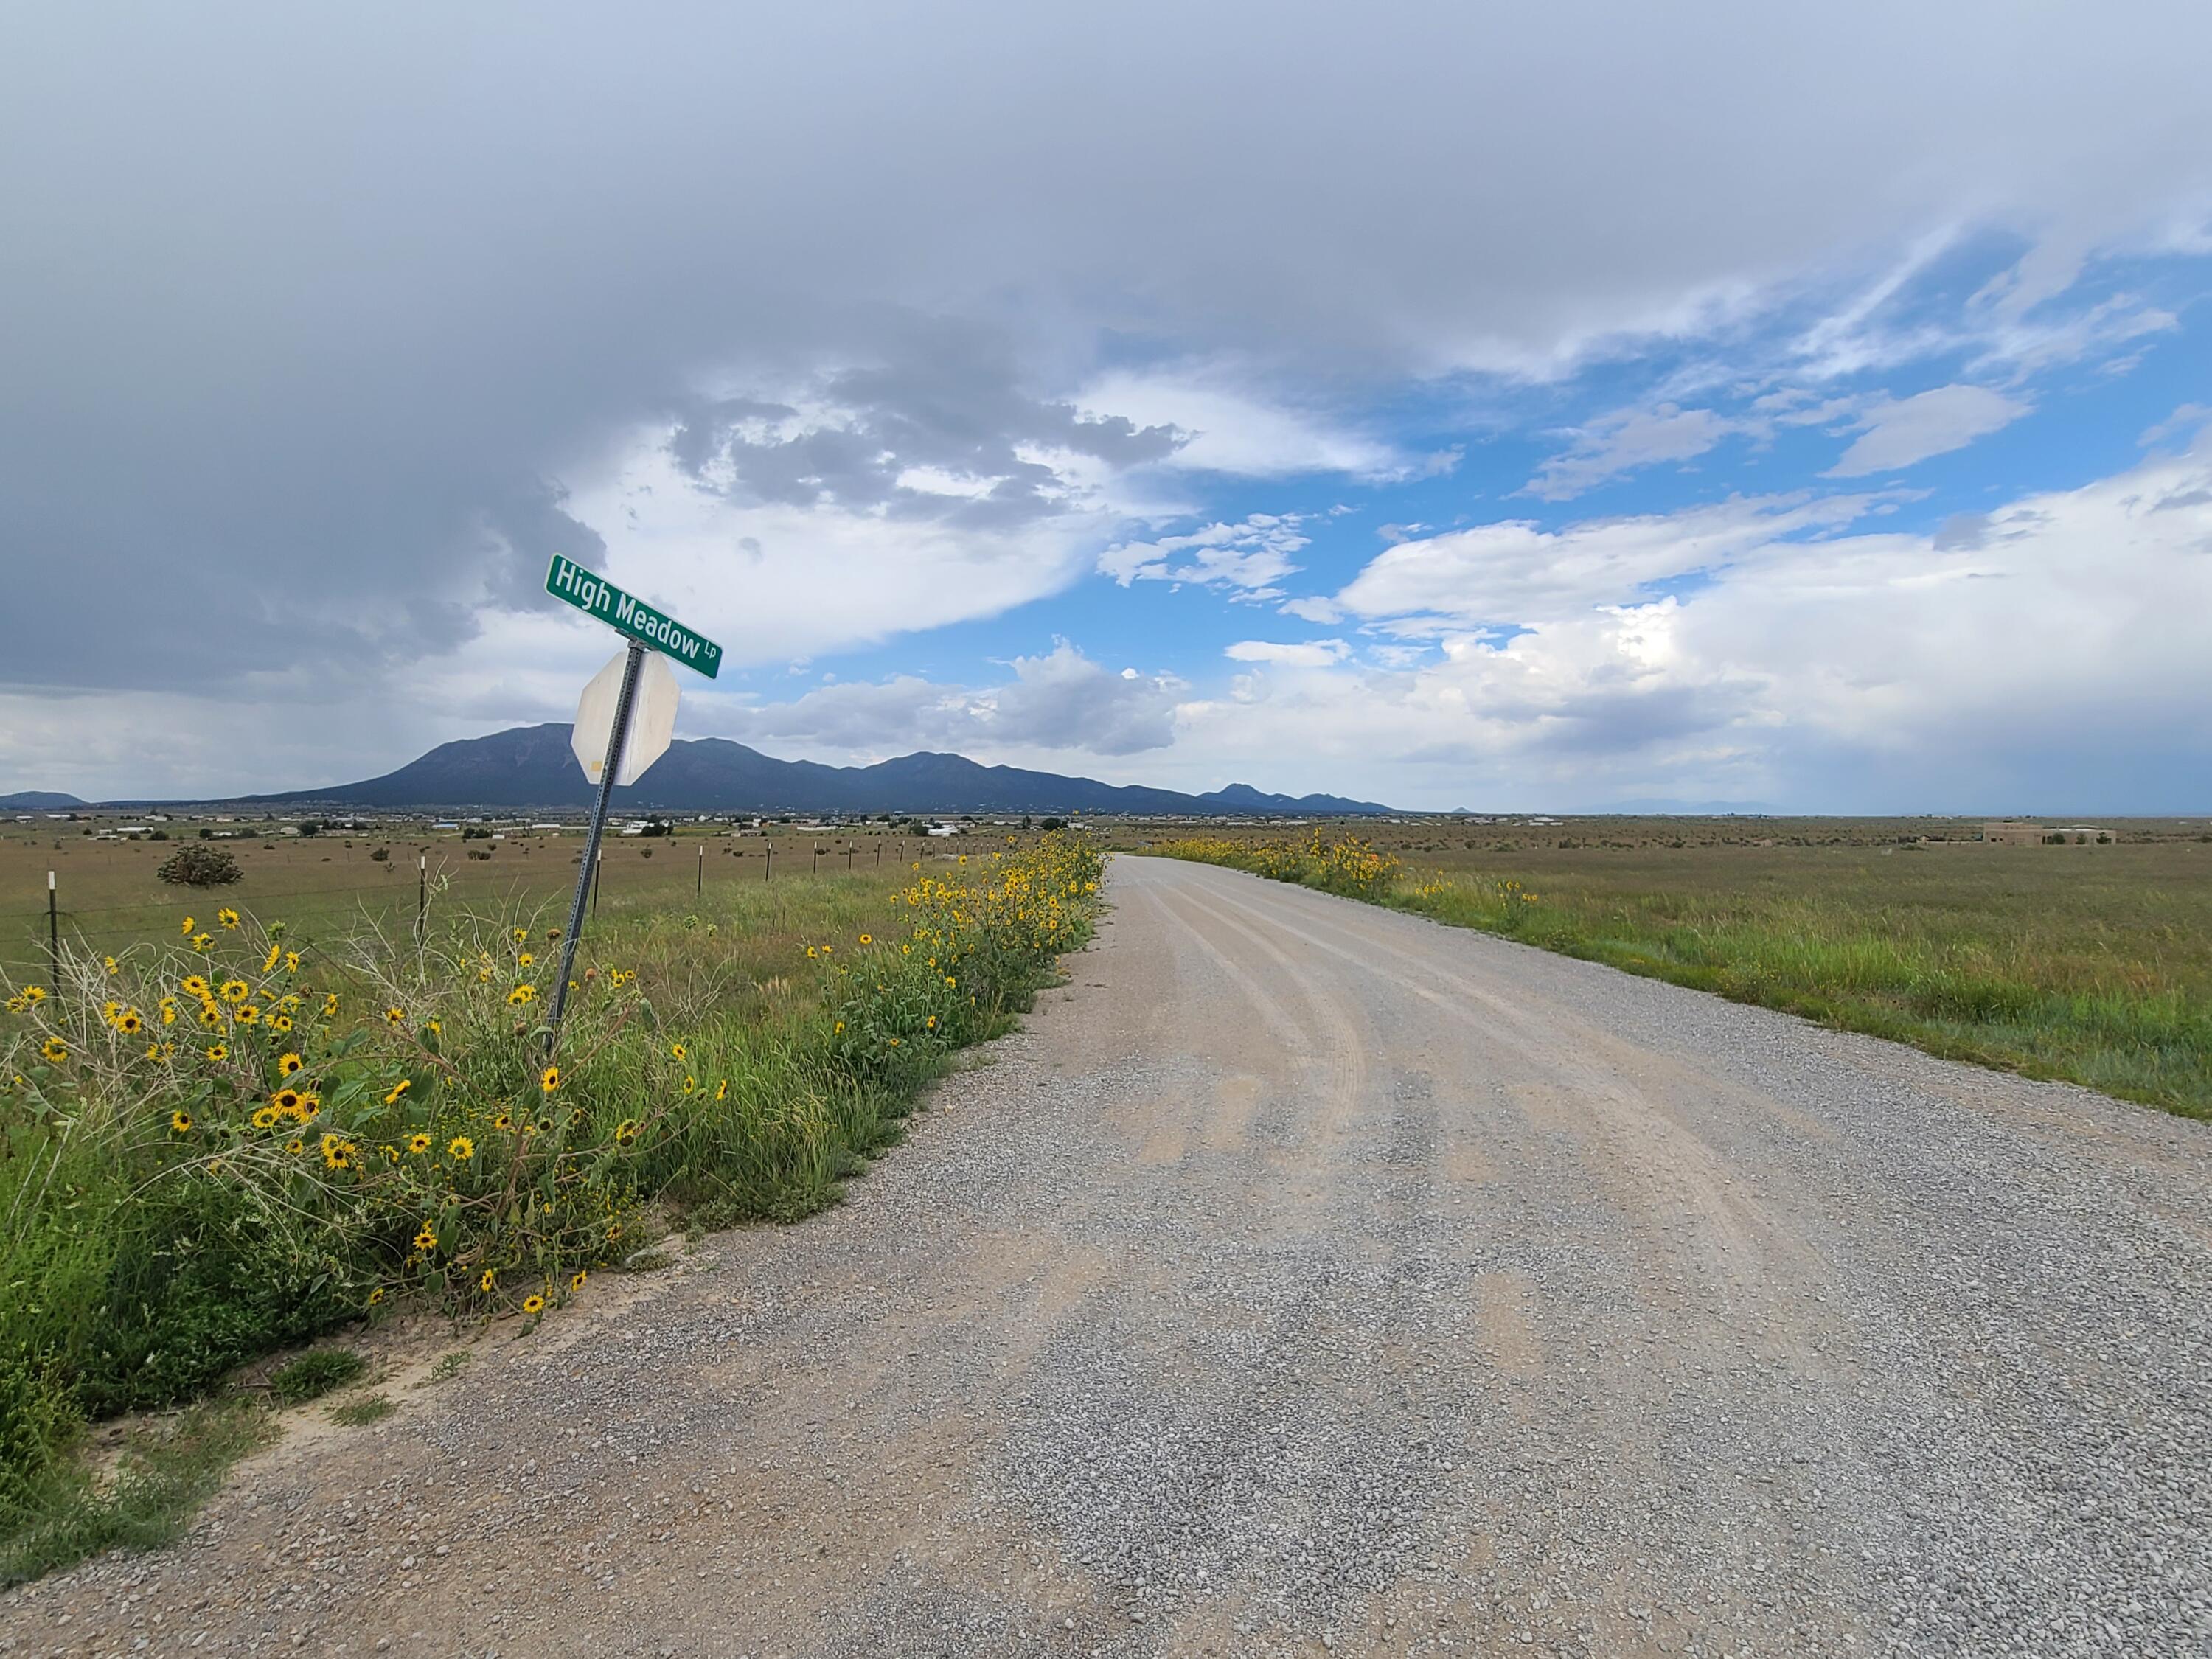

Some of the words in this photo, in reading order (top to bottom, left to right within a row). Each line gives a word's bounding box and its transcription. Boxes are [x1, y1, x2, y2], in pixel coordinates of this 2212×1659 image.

[555, 559, 611, 612] High
[615, 593, 700, 659] Meadow
[704, 641, 717, 659] Lp
